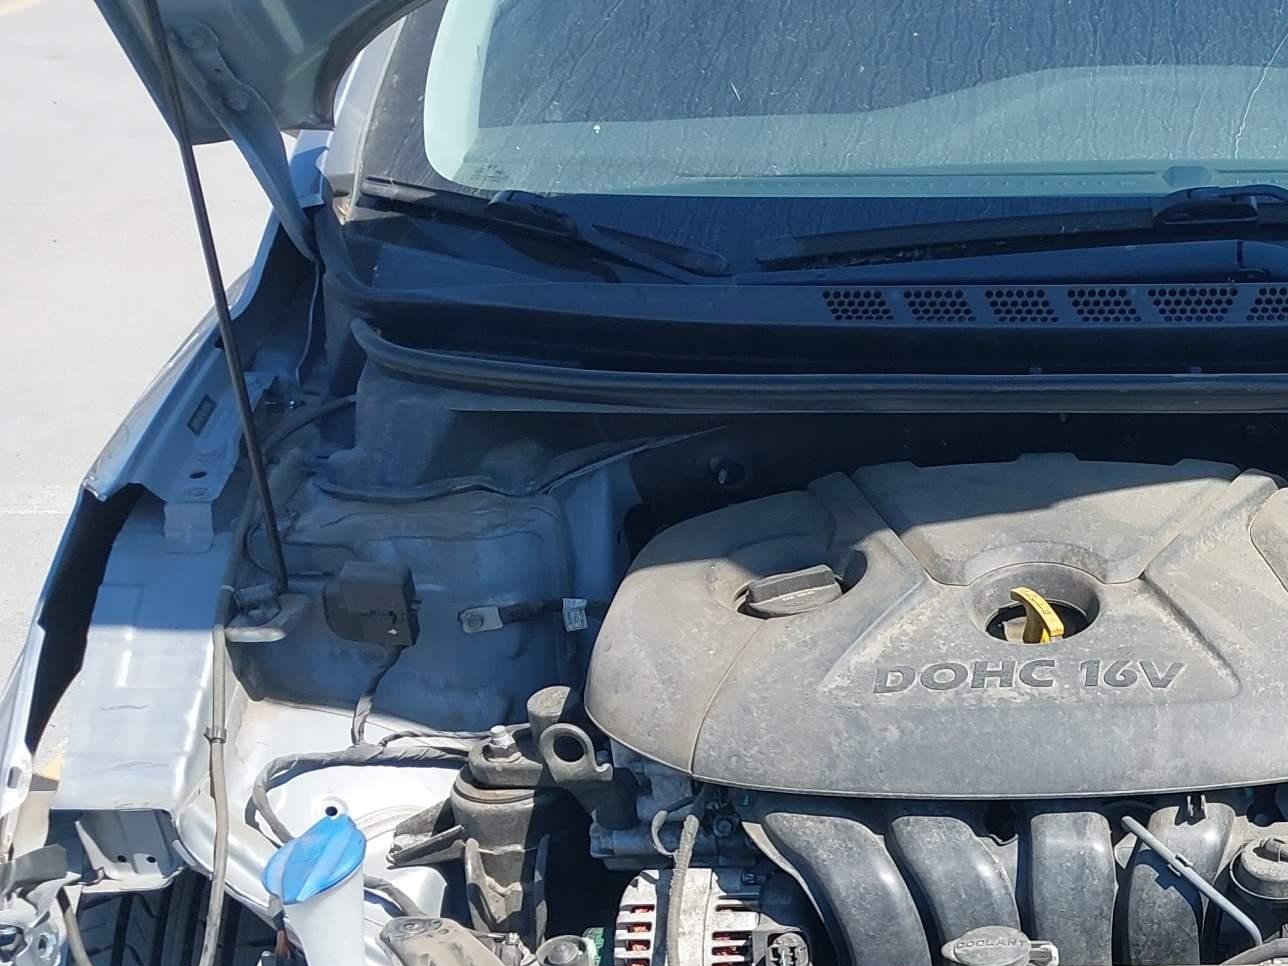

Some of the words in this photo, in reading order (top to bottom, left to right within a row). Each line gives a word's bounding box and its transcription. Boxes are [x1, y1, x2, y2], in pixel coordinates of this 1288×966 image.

[873, 659, 1056, 694] DOHC
[1079, 659, 1186, 689] 16V
[956, 939, 1025, 949] COOLANT
